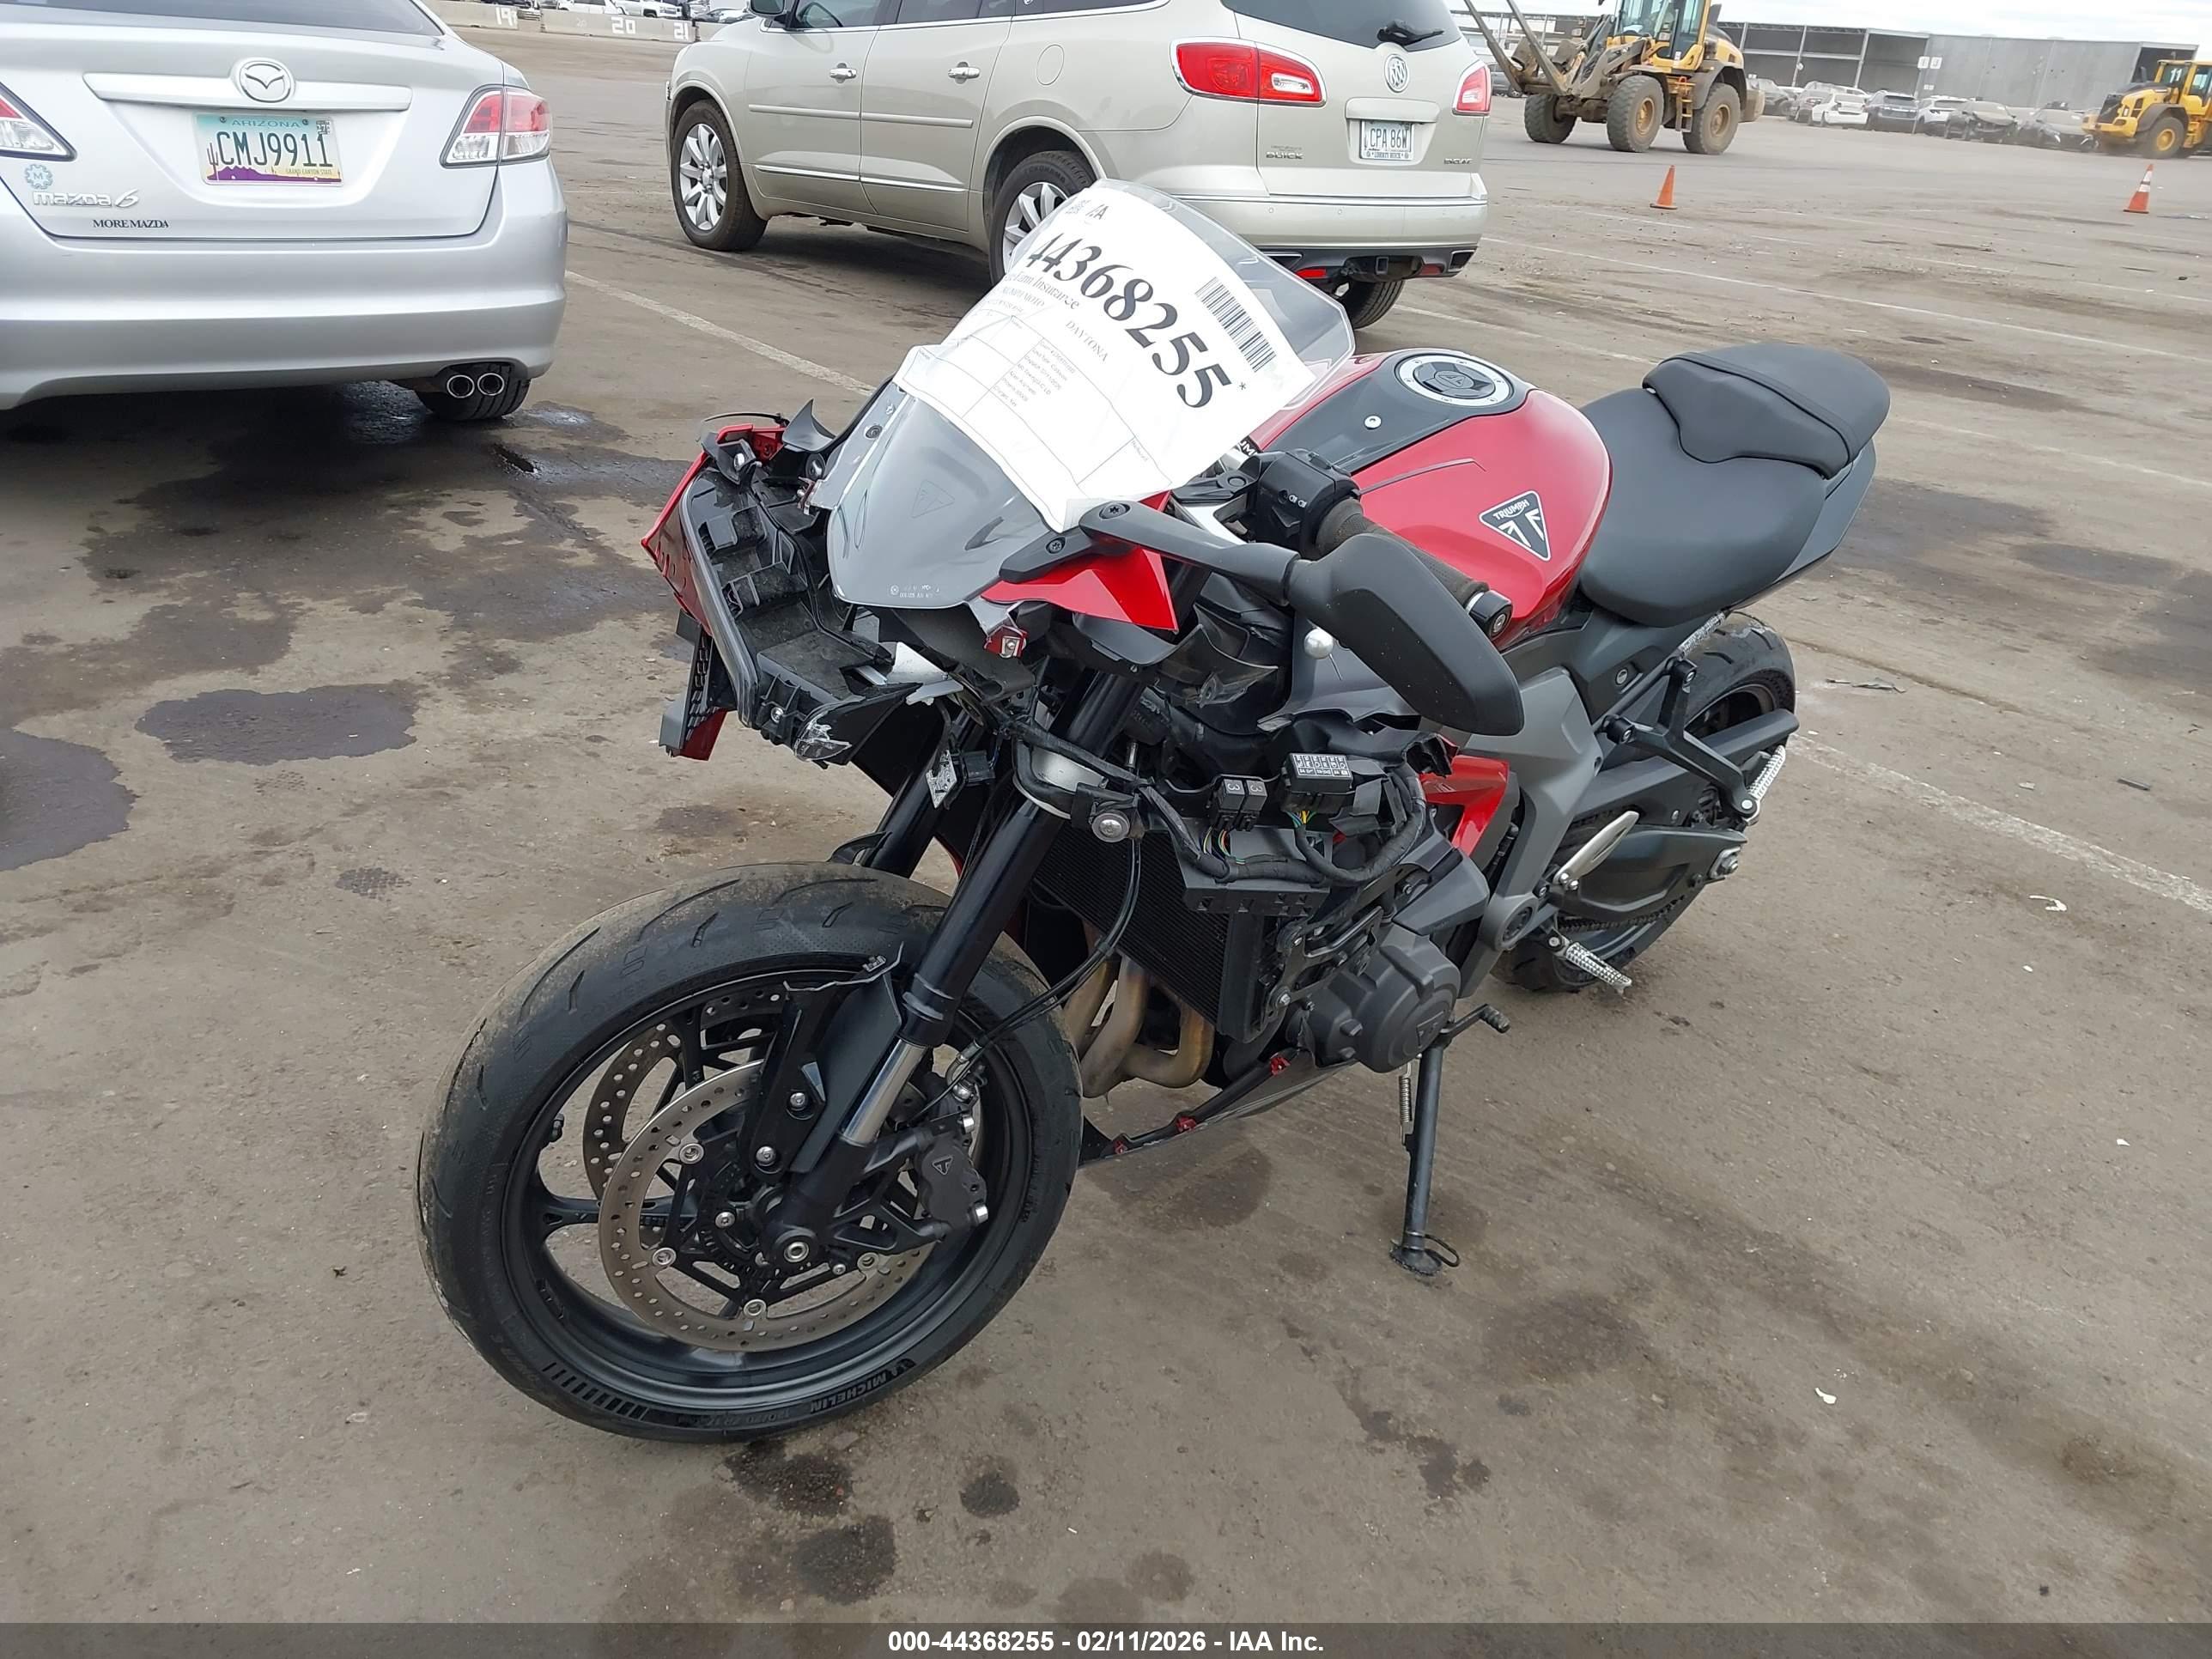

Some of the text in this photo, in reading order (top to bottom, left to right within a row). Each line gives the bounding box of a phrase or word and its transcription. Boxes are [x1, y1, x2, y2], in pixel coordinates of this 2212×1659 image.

[611, 16, 636, 35] 20
[674, 22, 689, 40] 21
[2169, 68, 2183, 83] 11
[231, 118, 301, 128] ARIZONA
[216, 131, 333, 167] CMJ9911
[1370, 128, 1409, 149] CPA 86W
[1266, 151, 1305, 160] BUICK
[114, 188, 140, 209] 6
[93, 219, 170, 229] MORE MAZDA
[1025, 233, 1233, 409] 44368255
[1065, 319, 1109, 362] DAYTONA
[1492, 499, 1530, 520] TRIUMPH
[810, 1370, 887, 1414] MICHELIN
